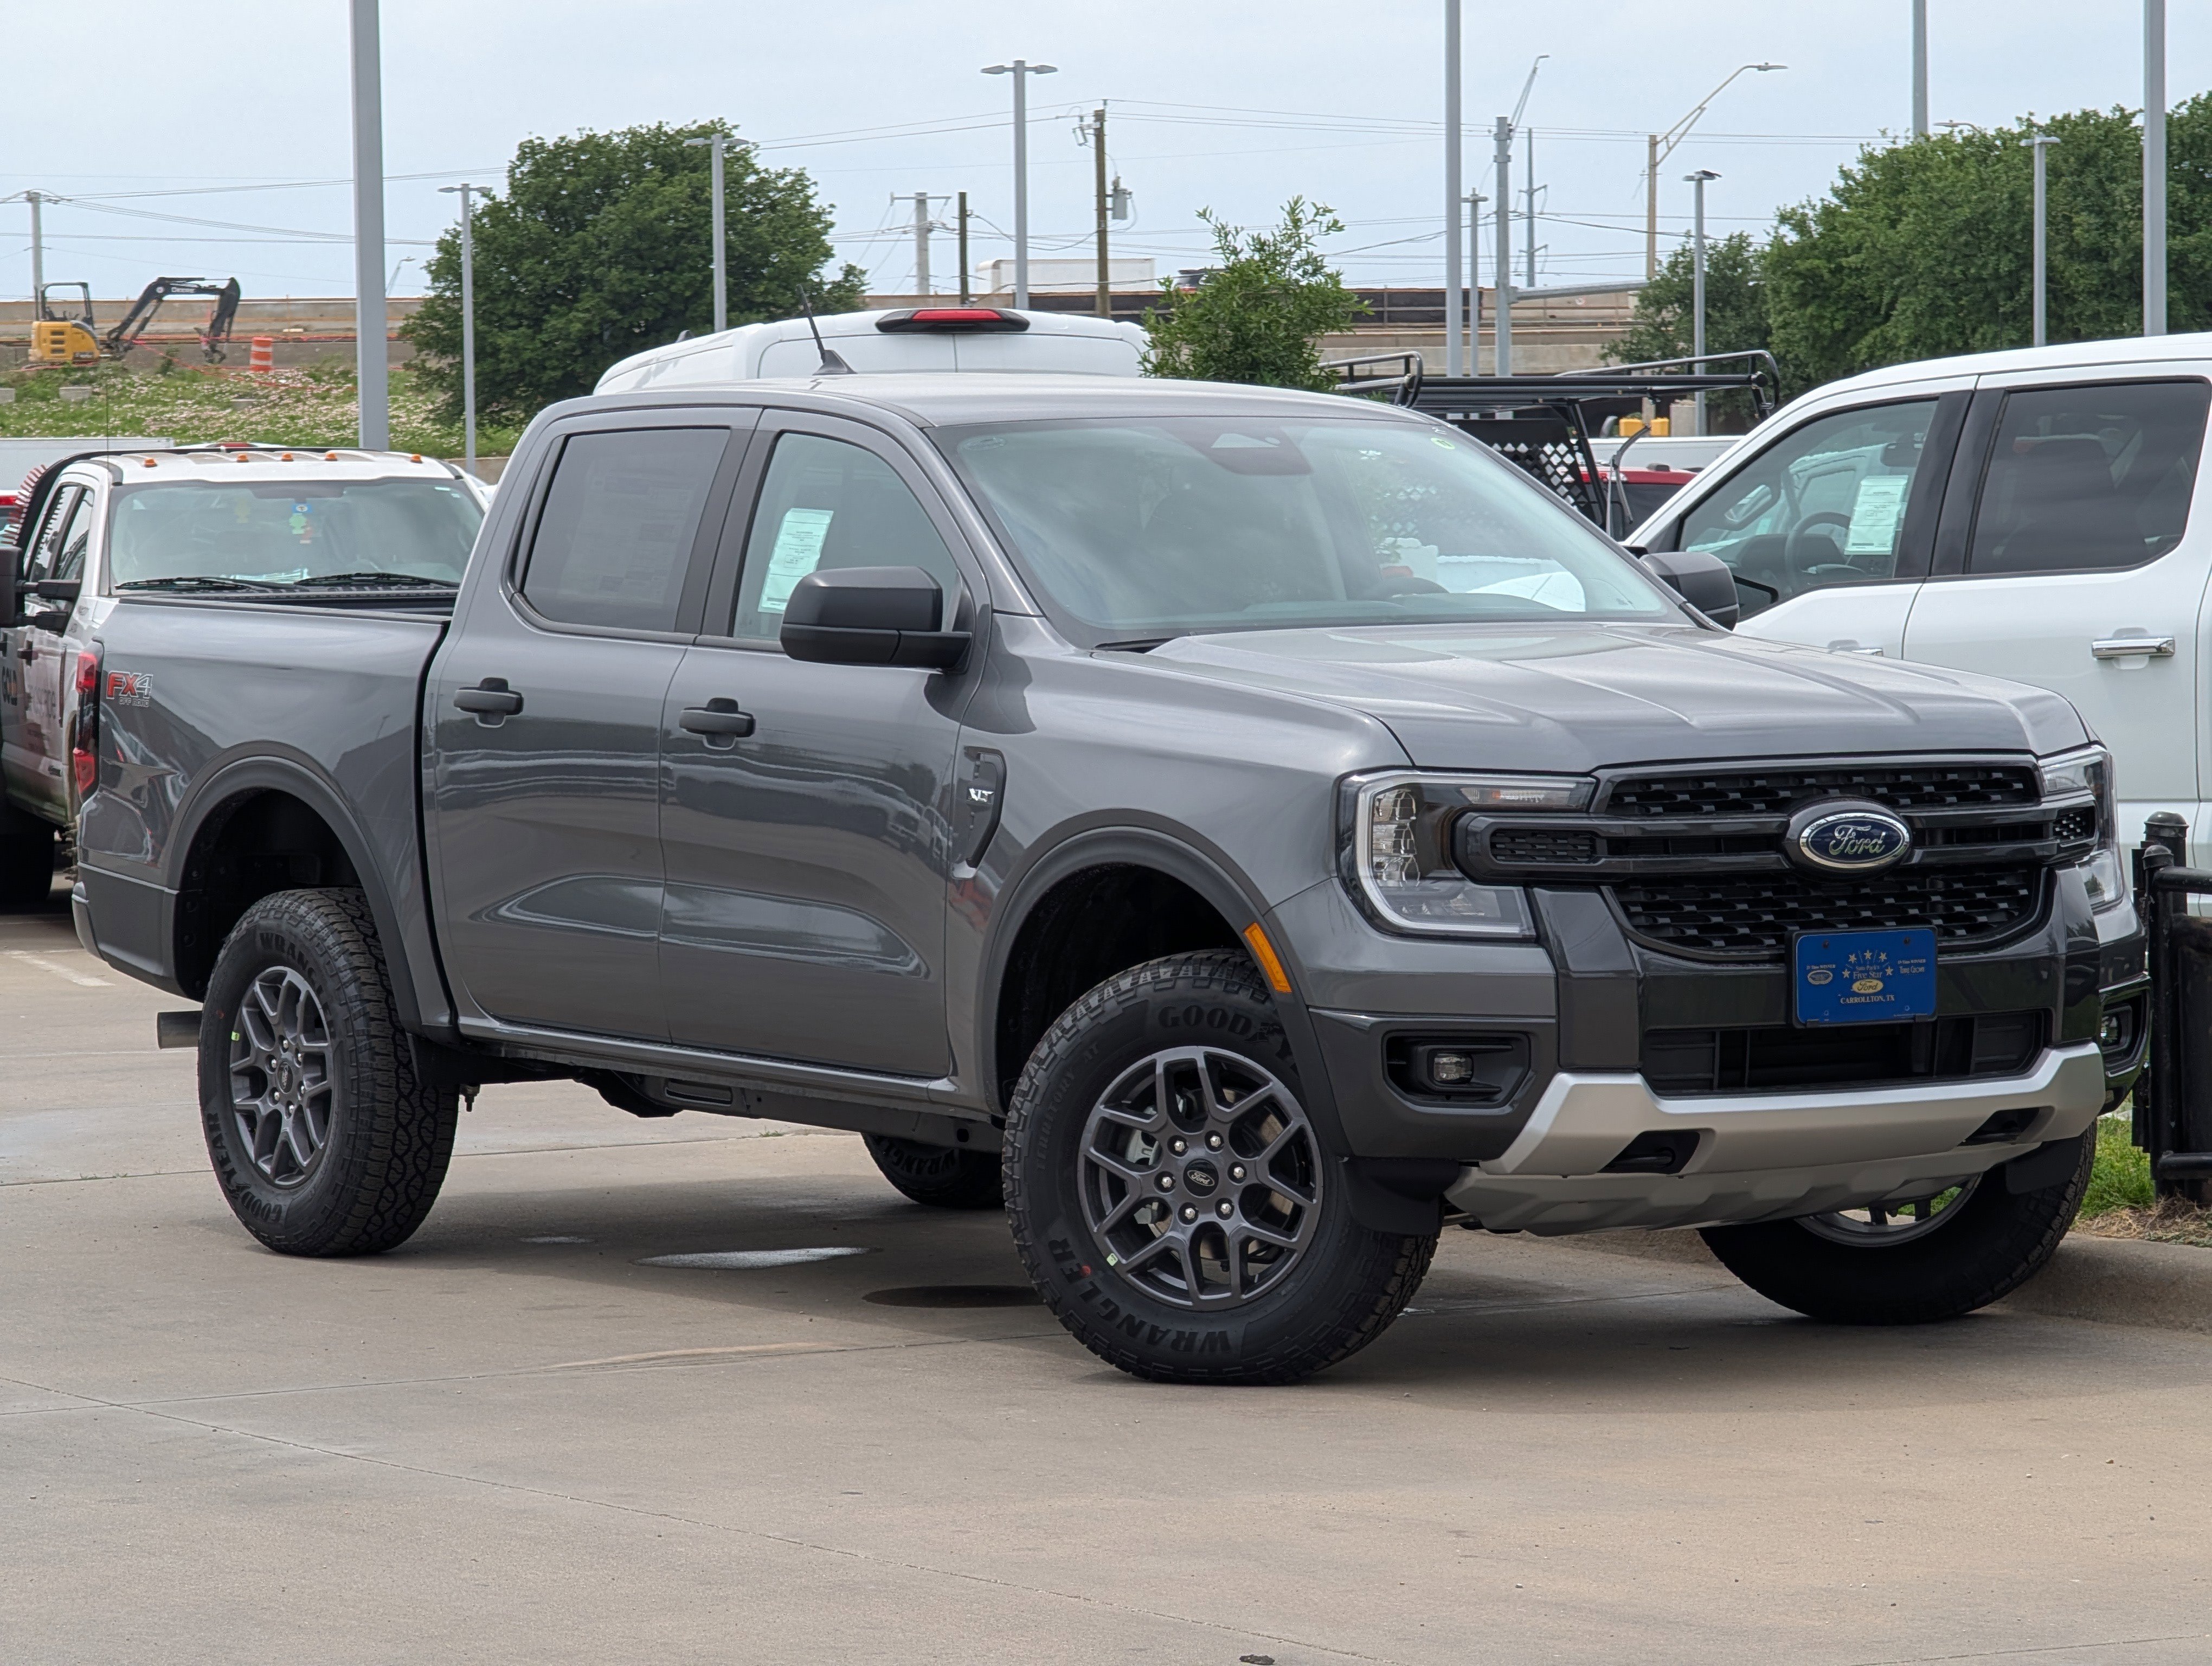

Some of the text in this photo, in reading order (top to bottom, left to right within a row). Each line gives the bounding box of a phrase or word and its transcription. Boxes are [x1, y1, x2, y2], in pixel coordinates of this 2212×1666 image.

[106, 670, 153, 700] FX4
[1829, 824, 1887, 855] Ford
[1857, 981, 1879, 991] Ford
[207, 1112, 282, 1222] GOODYEAR
[1048, 1237, 1231, 1354] WRANGLER
